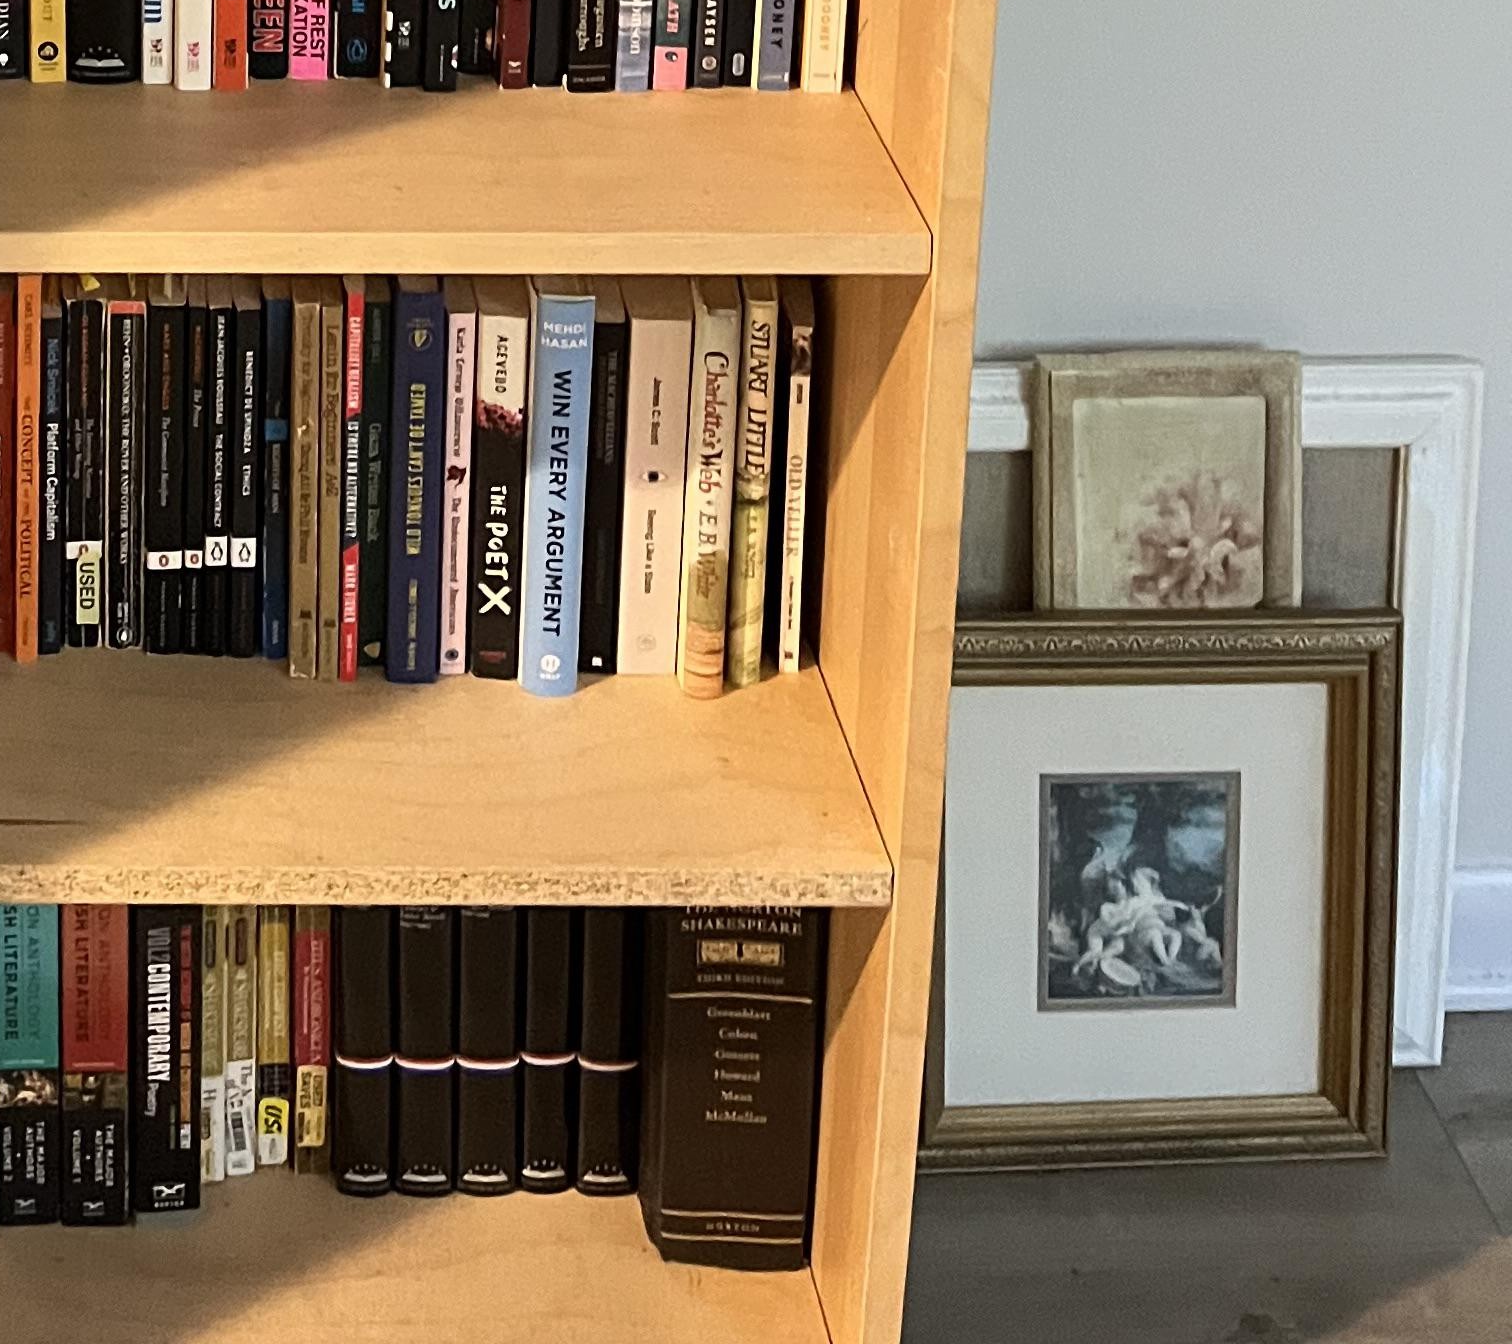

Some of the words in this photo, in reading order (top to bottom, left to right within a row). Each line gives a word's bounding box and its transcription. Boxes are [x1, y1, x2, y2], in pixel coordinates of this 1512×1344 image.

[309, 14, 325, 61] REST
[747, 320, 770, 397] STUART
[551, 371, 572, 417] WIN
[702, 351, 729, 450] Charlotte's
[548, 426, 568, 501] EVERY
[699, 451, 724, 493] Web
[745, 407, 765, 477] LITTLE
[490, 486, 506, 515] THE
[484, 522, 508, 578] POET
[543, 508, 565, 637] ARGUMENT
[80, 563, 95, 610] USED
[478, 583, 511, 615] X
[4, 935, 18, 1041] LITERATURE
[147, 963, 170, 1081] CONTEMPORARY
